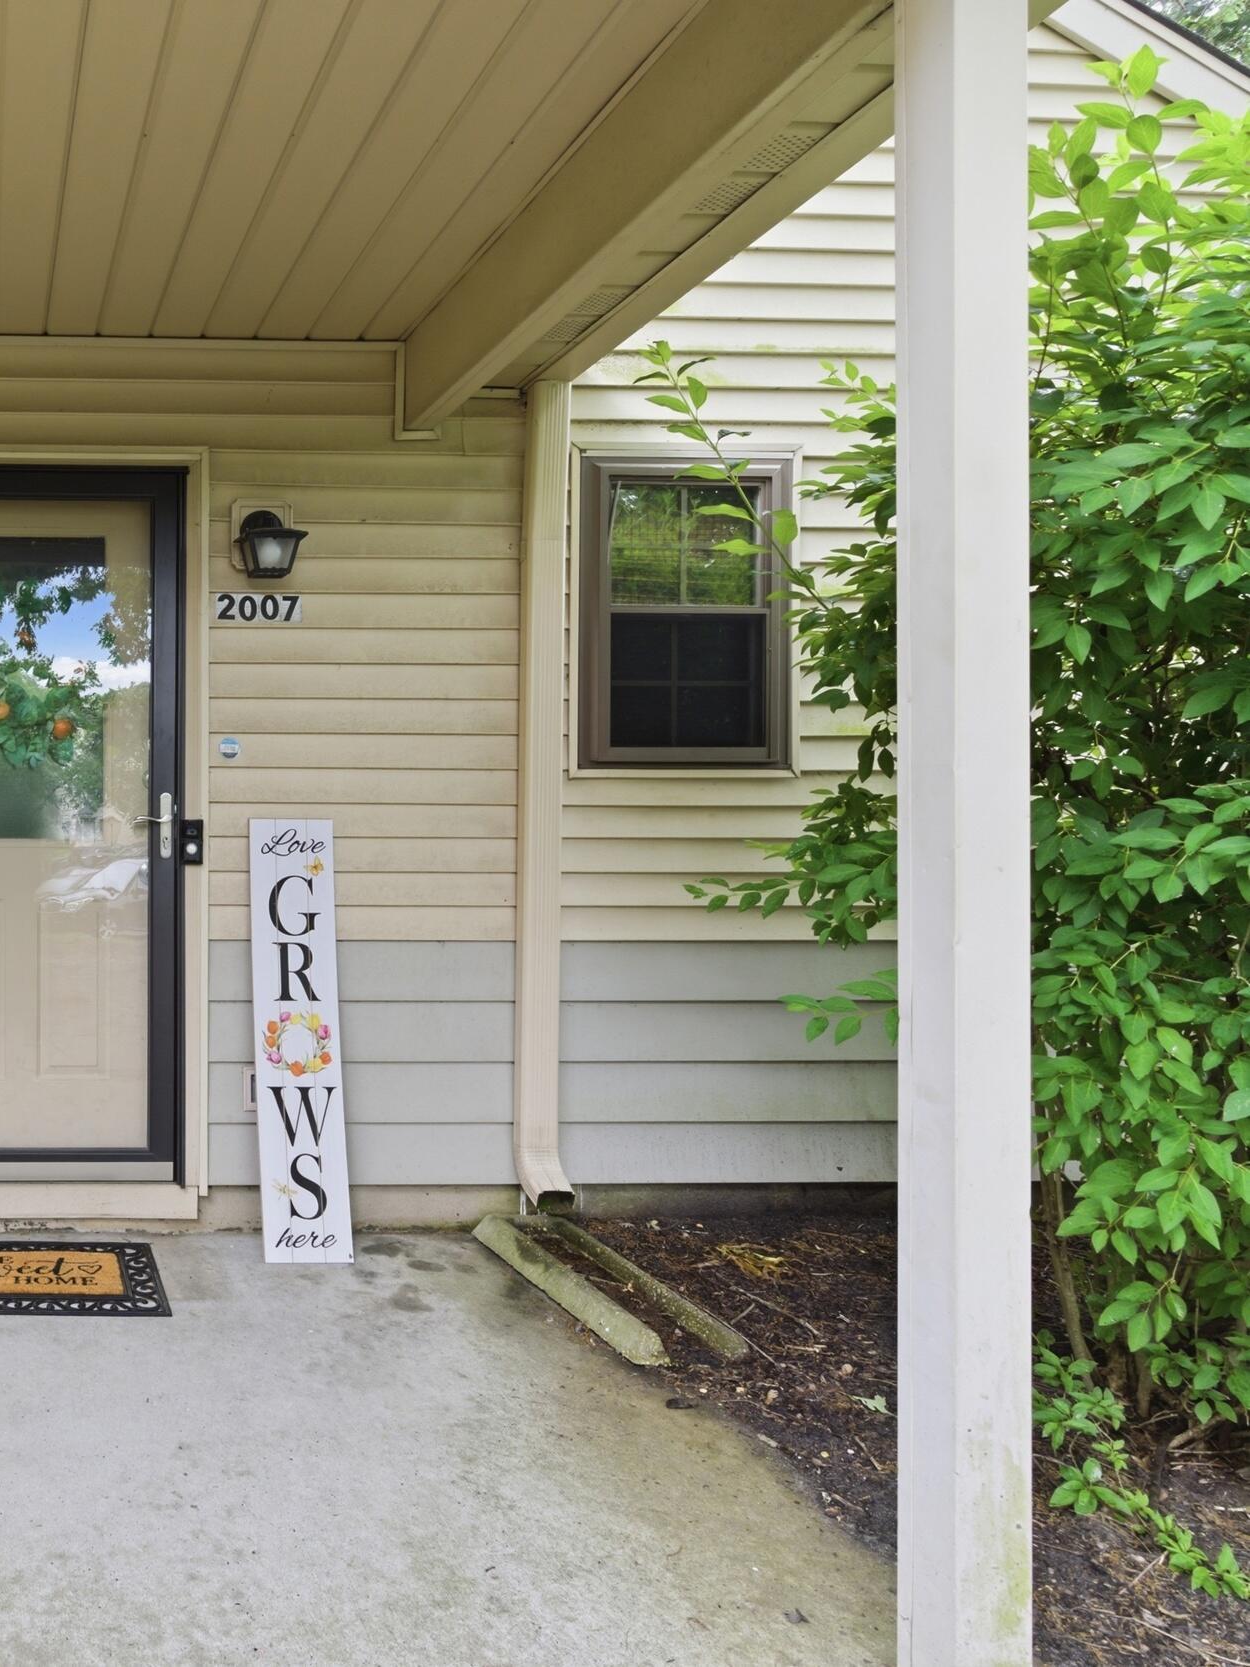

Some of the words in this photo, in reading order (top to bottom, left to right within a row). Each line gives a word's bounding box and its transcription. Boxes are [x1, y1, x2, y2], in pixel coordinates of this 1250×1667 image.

[217, 594, 300, 622] 2007
[260, 828, 327, 857] Love
[275, 1227, 338, 1249] here
[14, 1275, 99, 1286] HOME
